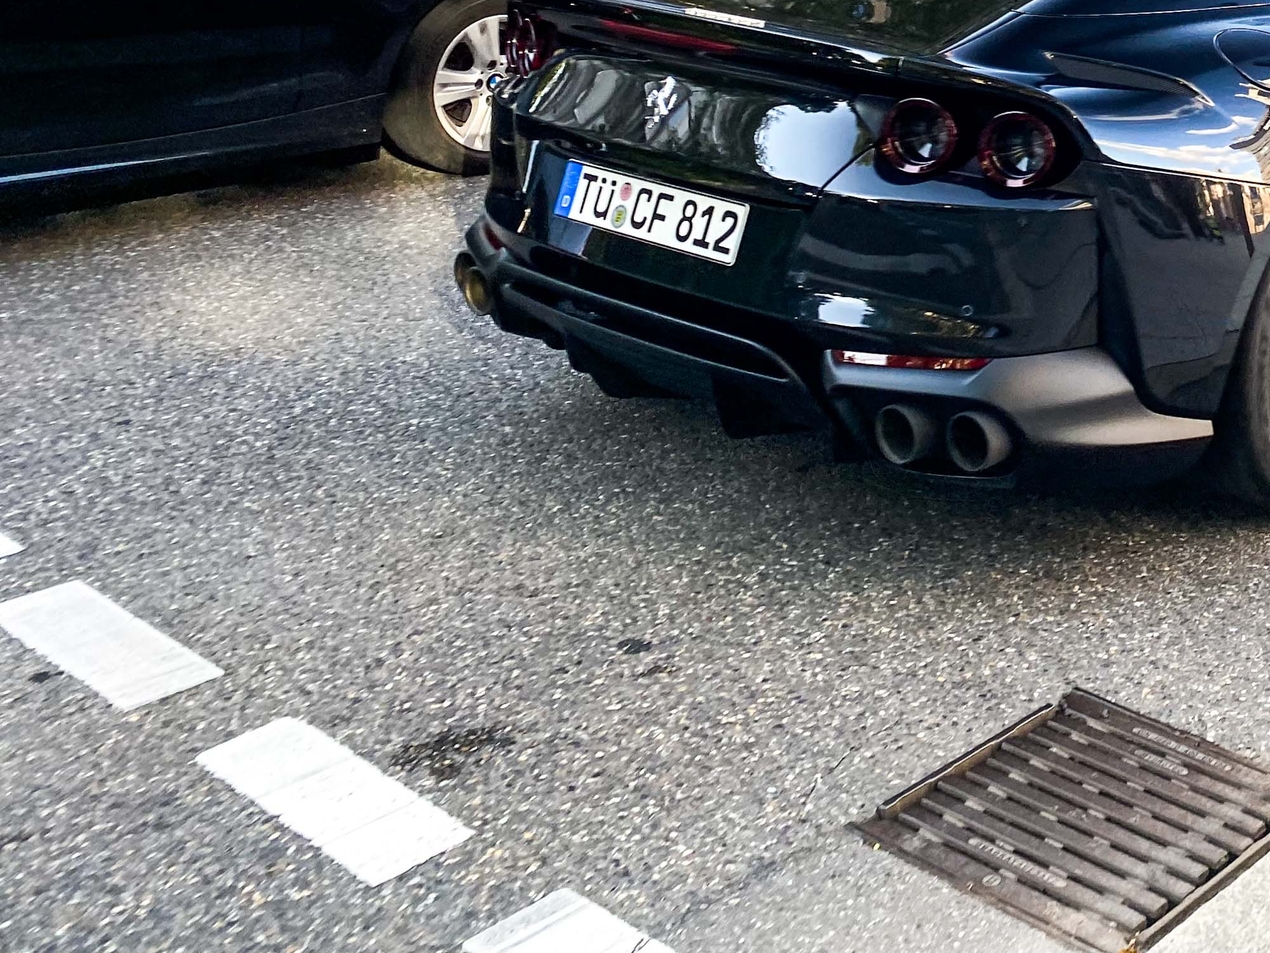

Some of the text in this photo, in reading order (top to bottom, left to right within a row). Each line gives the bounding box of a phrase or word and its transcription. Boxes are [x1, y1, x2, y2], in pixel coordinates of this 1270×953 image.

[579, 172, 739, 255] TÜ CF 812
